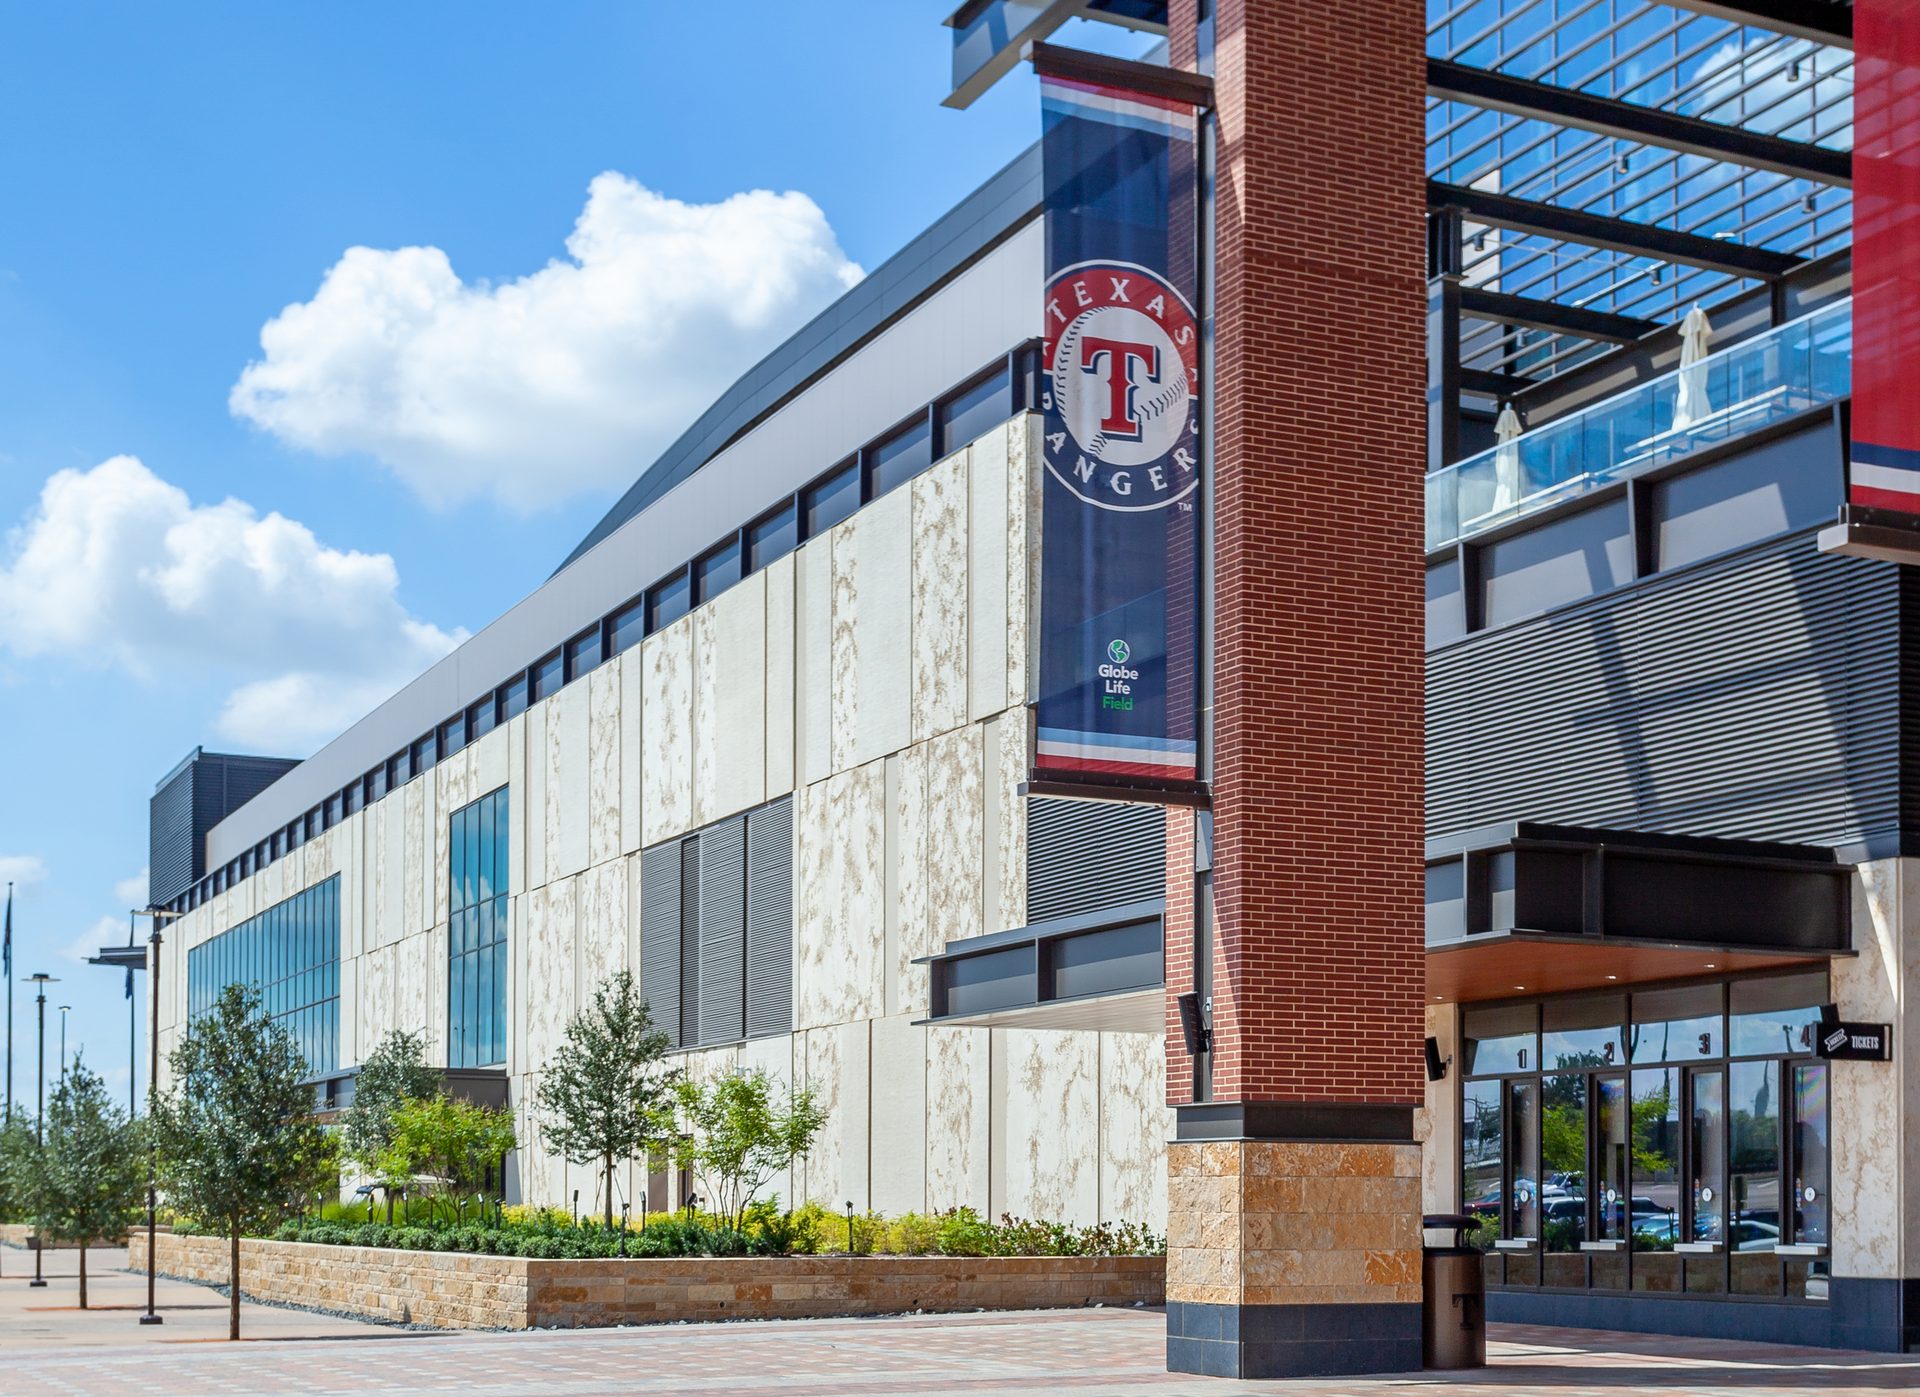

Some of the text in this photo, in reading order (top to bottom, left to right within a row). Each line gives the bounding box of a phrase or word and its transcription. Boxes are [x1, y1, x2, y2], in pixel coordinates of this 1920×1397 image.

[1046, 277, 1194, 345] TEXAS
[1081, 336, 1160, 442] T
[1178, 502, 1192, 512] TM
[1098, 664, 1138, 680] Globe
[1105, 680, 1131, 694] Life
[1103, 696, 1133, 711] Field
[1699, 1033, 1711, 1054] 3
[1851, 1035, 1879, 1049] TICKETS
[1517, 1049, 1527, 1069] 1
[1603, 1041, 1615, 1063] 2
